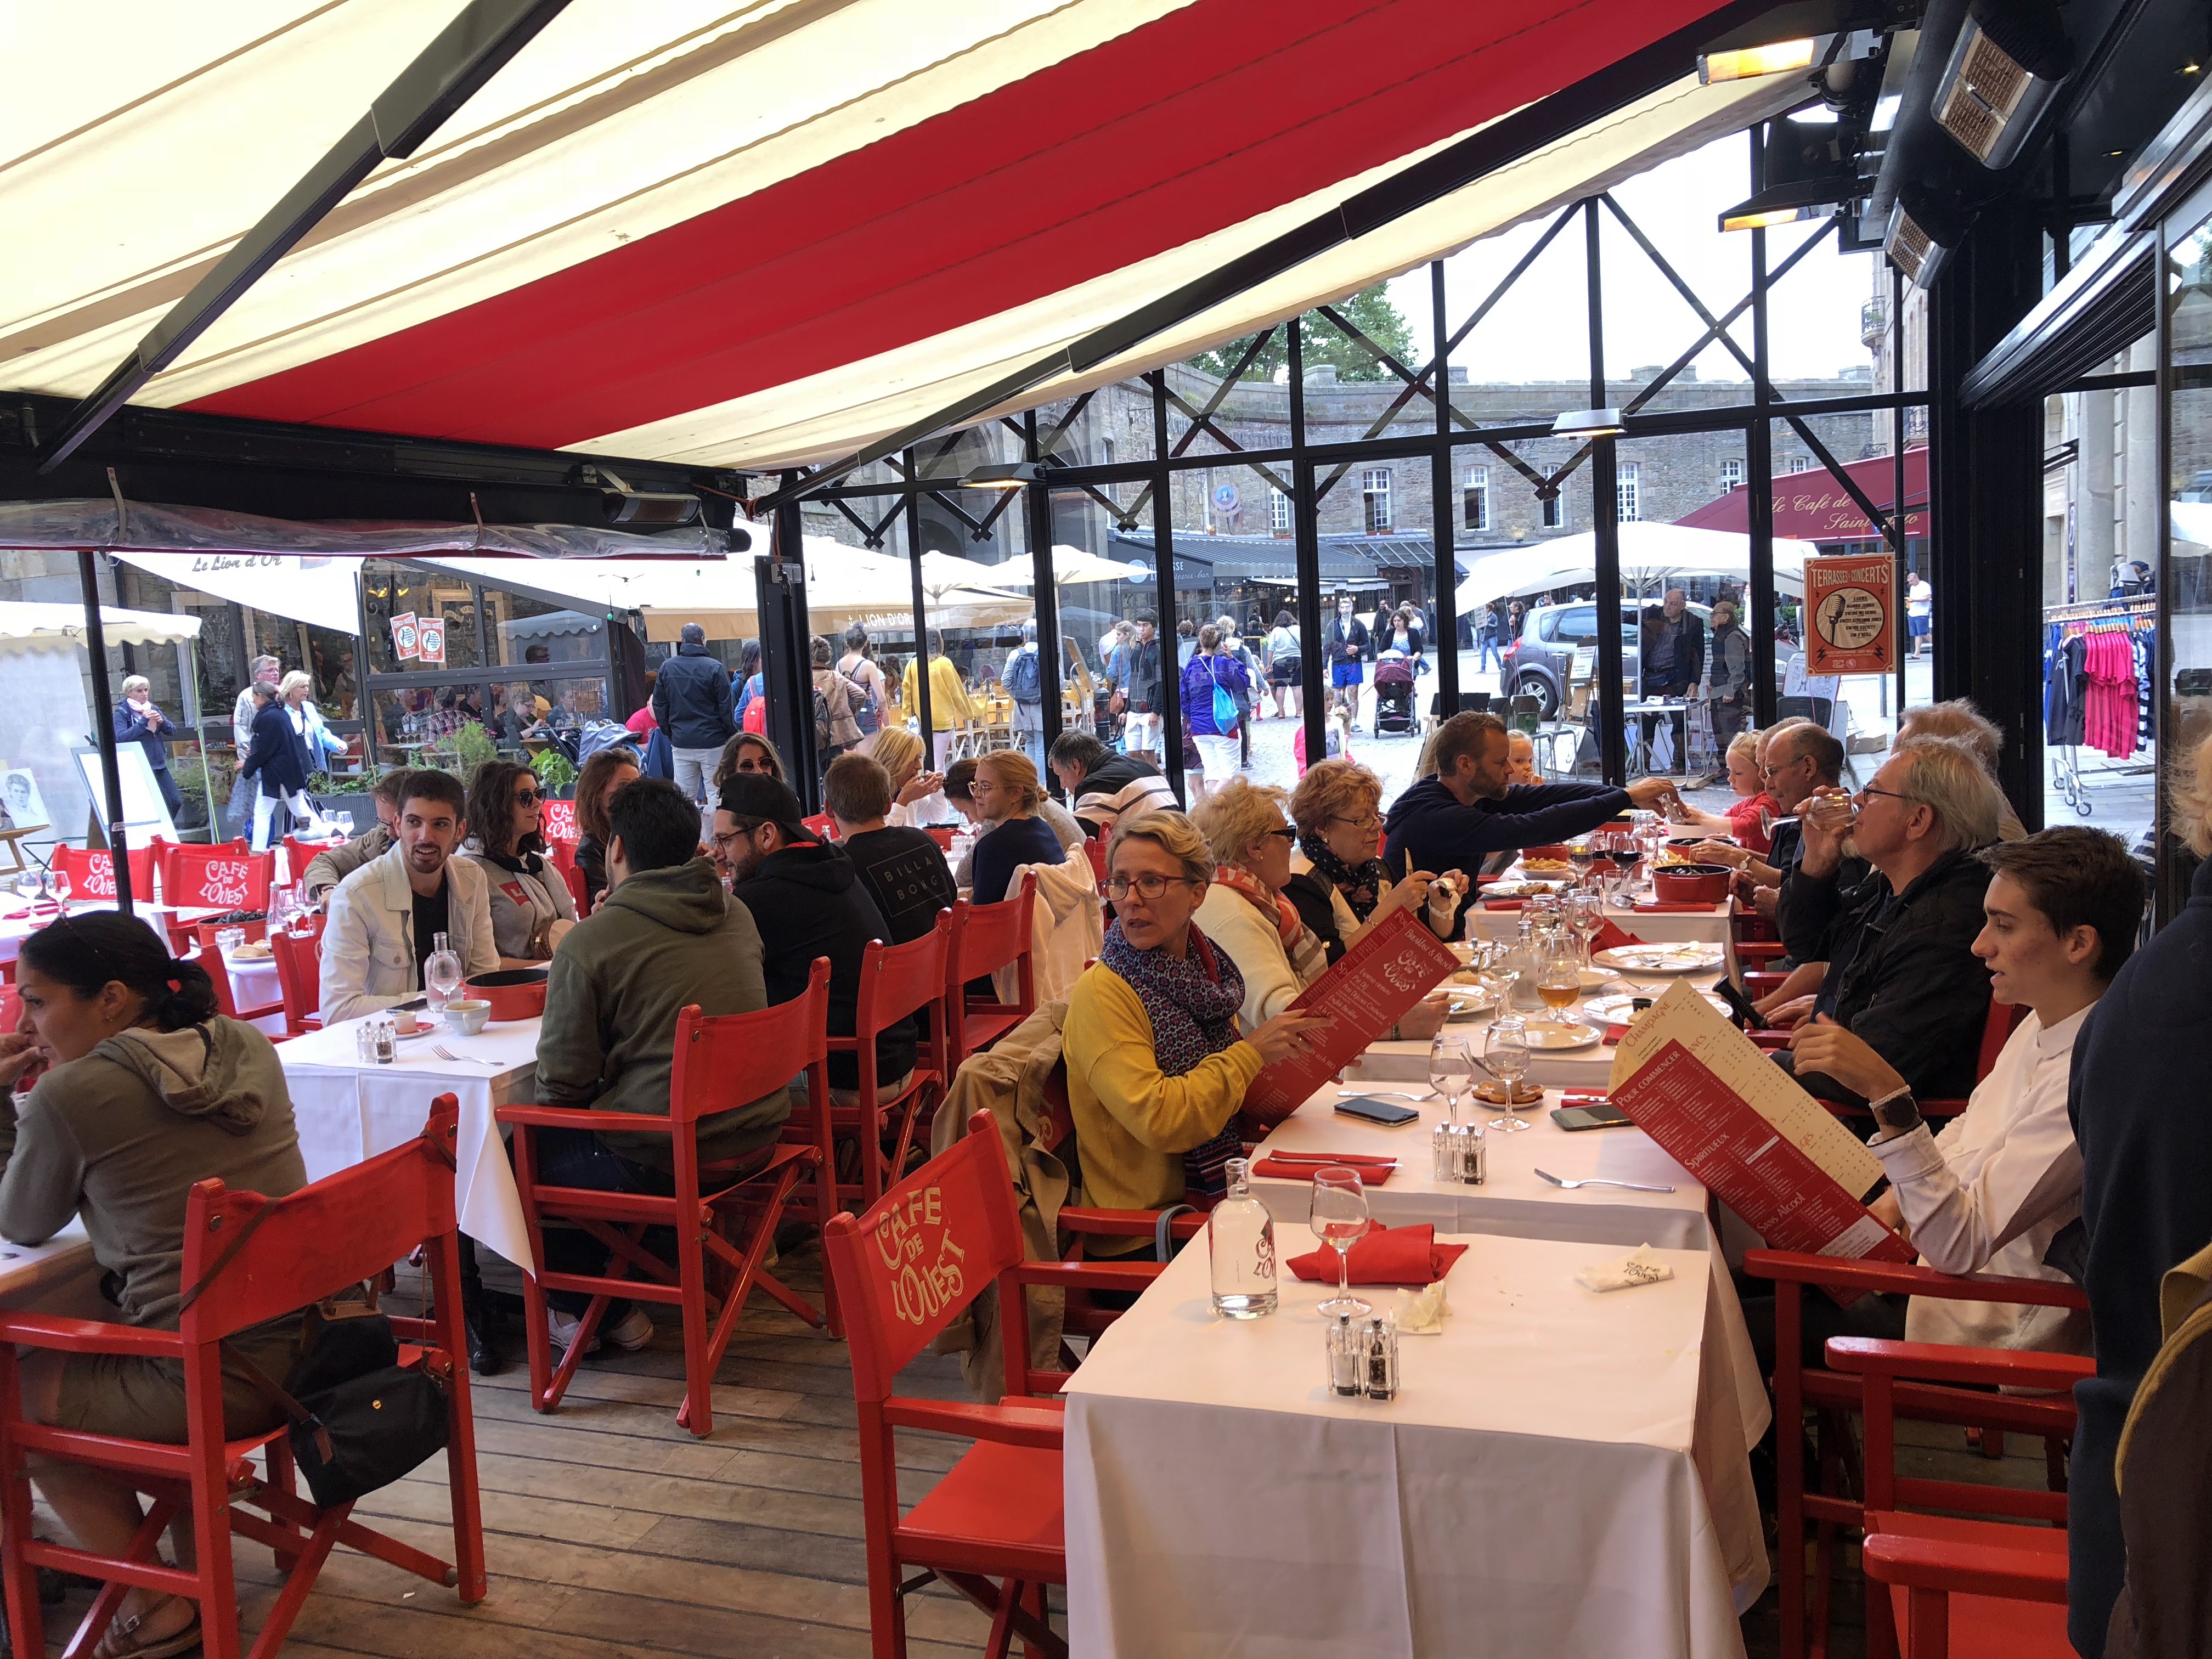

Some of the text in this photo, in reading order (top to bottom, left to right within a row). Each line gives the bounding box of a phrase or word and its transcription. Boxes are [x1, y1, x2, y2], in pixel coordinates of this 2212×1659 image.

[1792, 493, 1830, 515] Café
[1832, 493, 1850, 507] de
[192, 557, 208, 572] Le
[211, 555, 241, 571] Lion
[1811, 564, 1888, 588] TERRASSES CONCERTS
[887, 613, 912, 626] D'OR
[550, 804, 574, 821] CA
[89, 854, 114, 874] CA
[205, 860, 249, 882] CAFÉ
[884, 856, 932, 882] BILLA
[896, 875, 937, 901] BONG
[905, 1232, 924, 1263] DE
